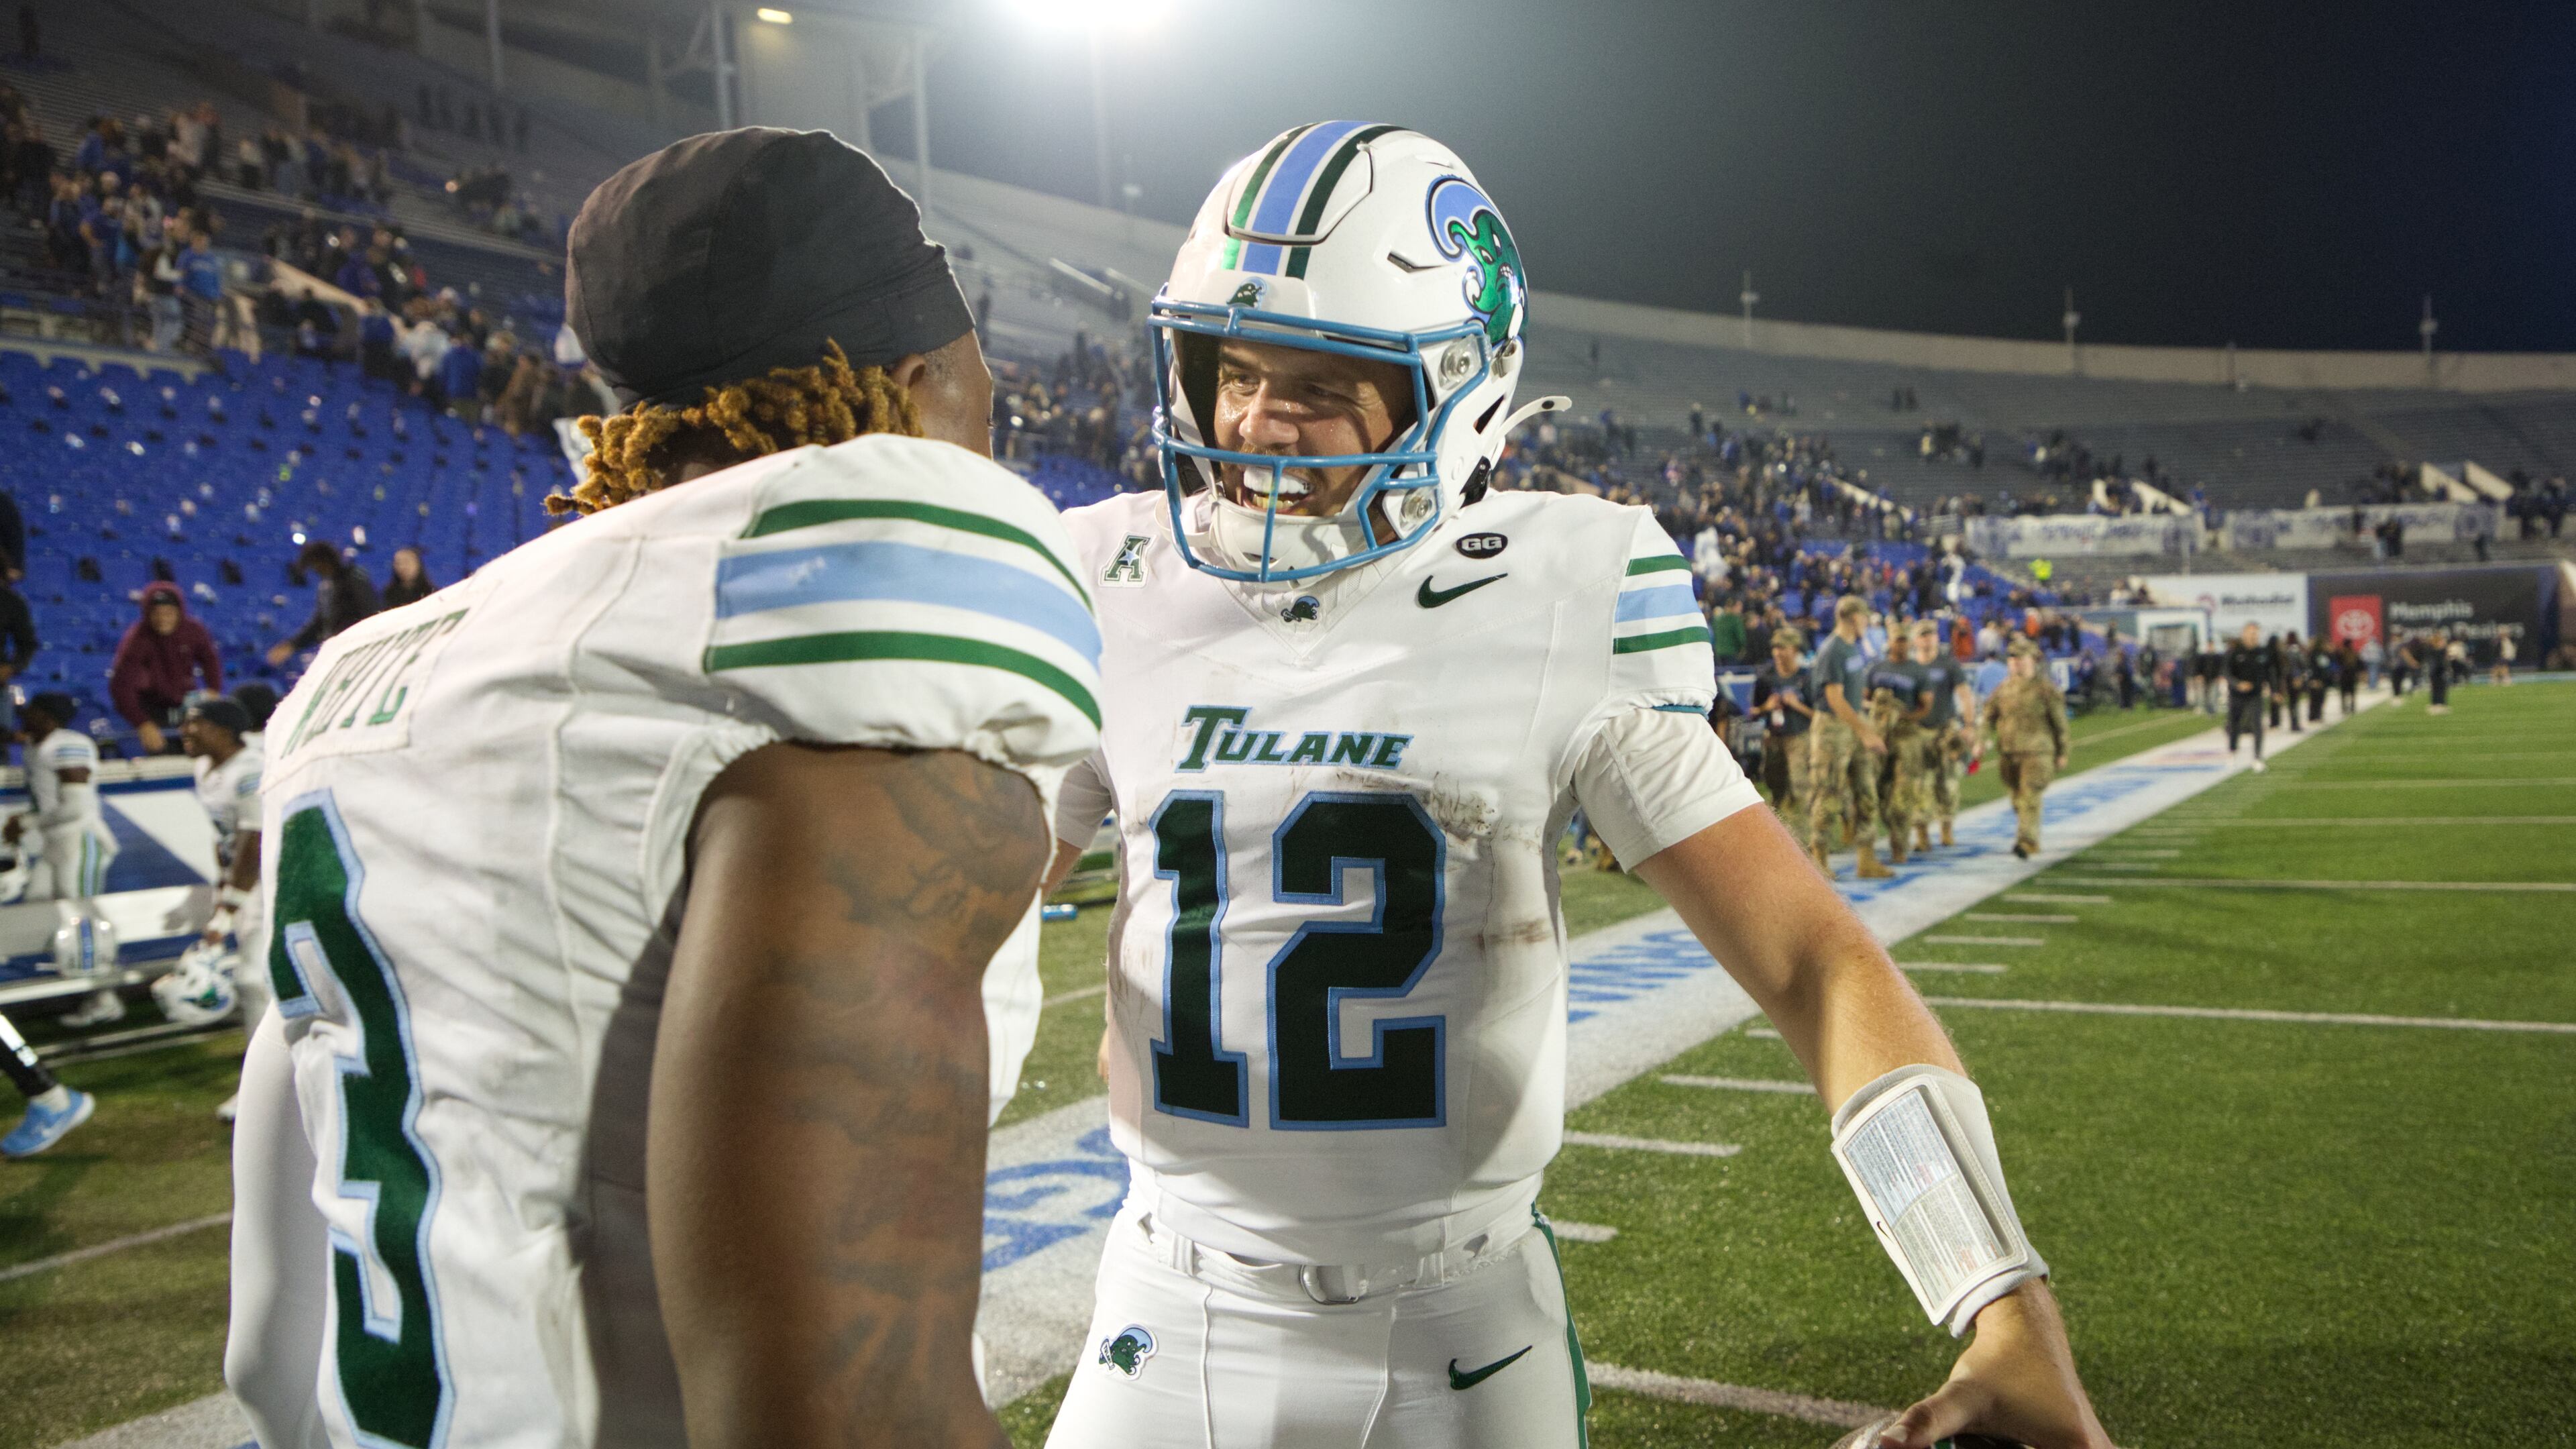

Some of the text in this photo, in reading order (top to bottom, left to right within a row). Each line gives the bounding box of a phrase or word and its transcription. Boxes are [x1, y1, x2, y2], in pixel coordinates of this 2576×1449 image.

[1104, 535, 1150, 582] A
[1461, 536, 1502, 551] GG
[1174, 704, 1414, 773] TULANE
[1148, 789, 1447, 1132] 12
[267, 786, 457, 1449] 3
